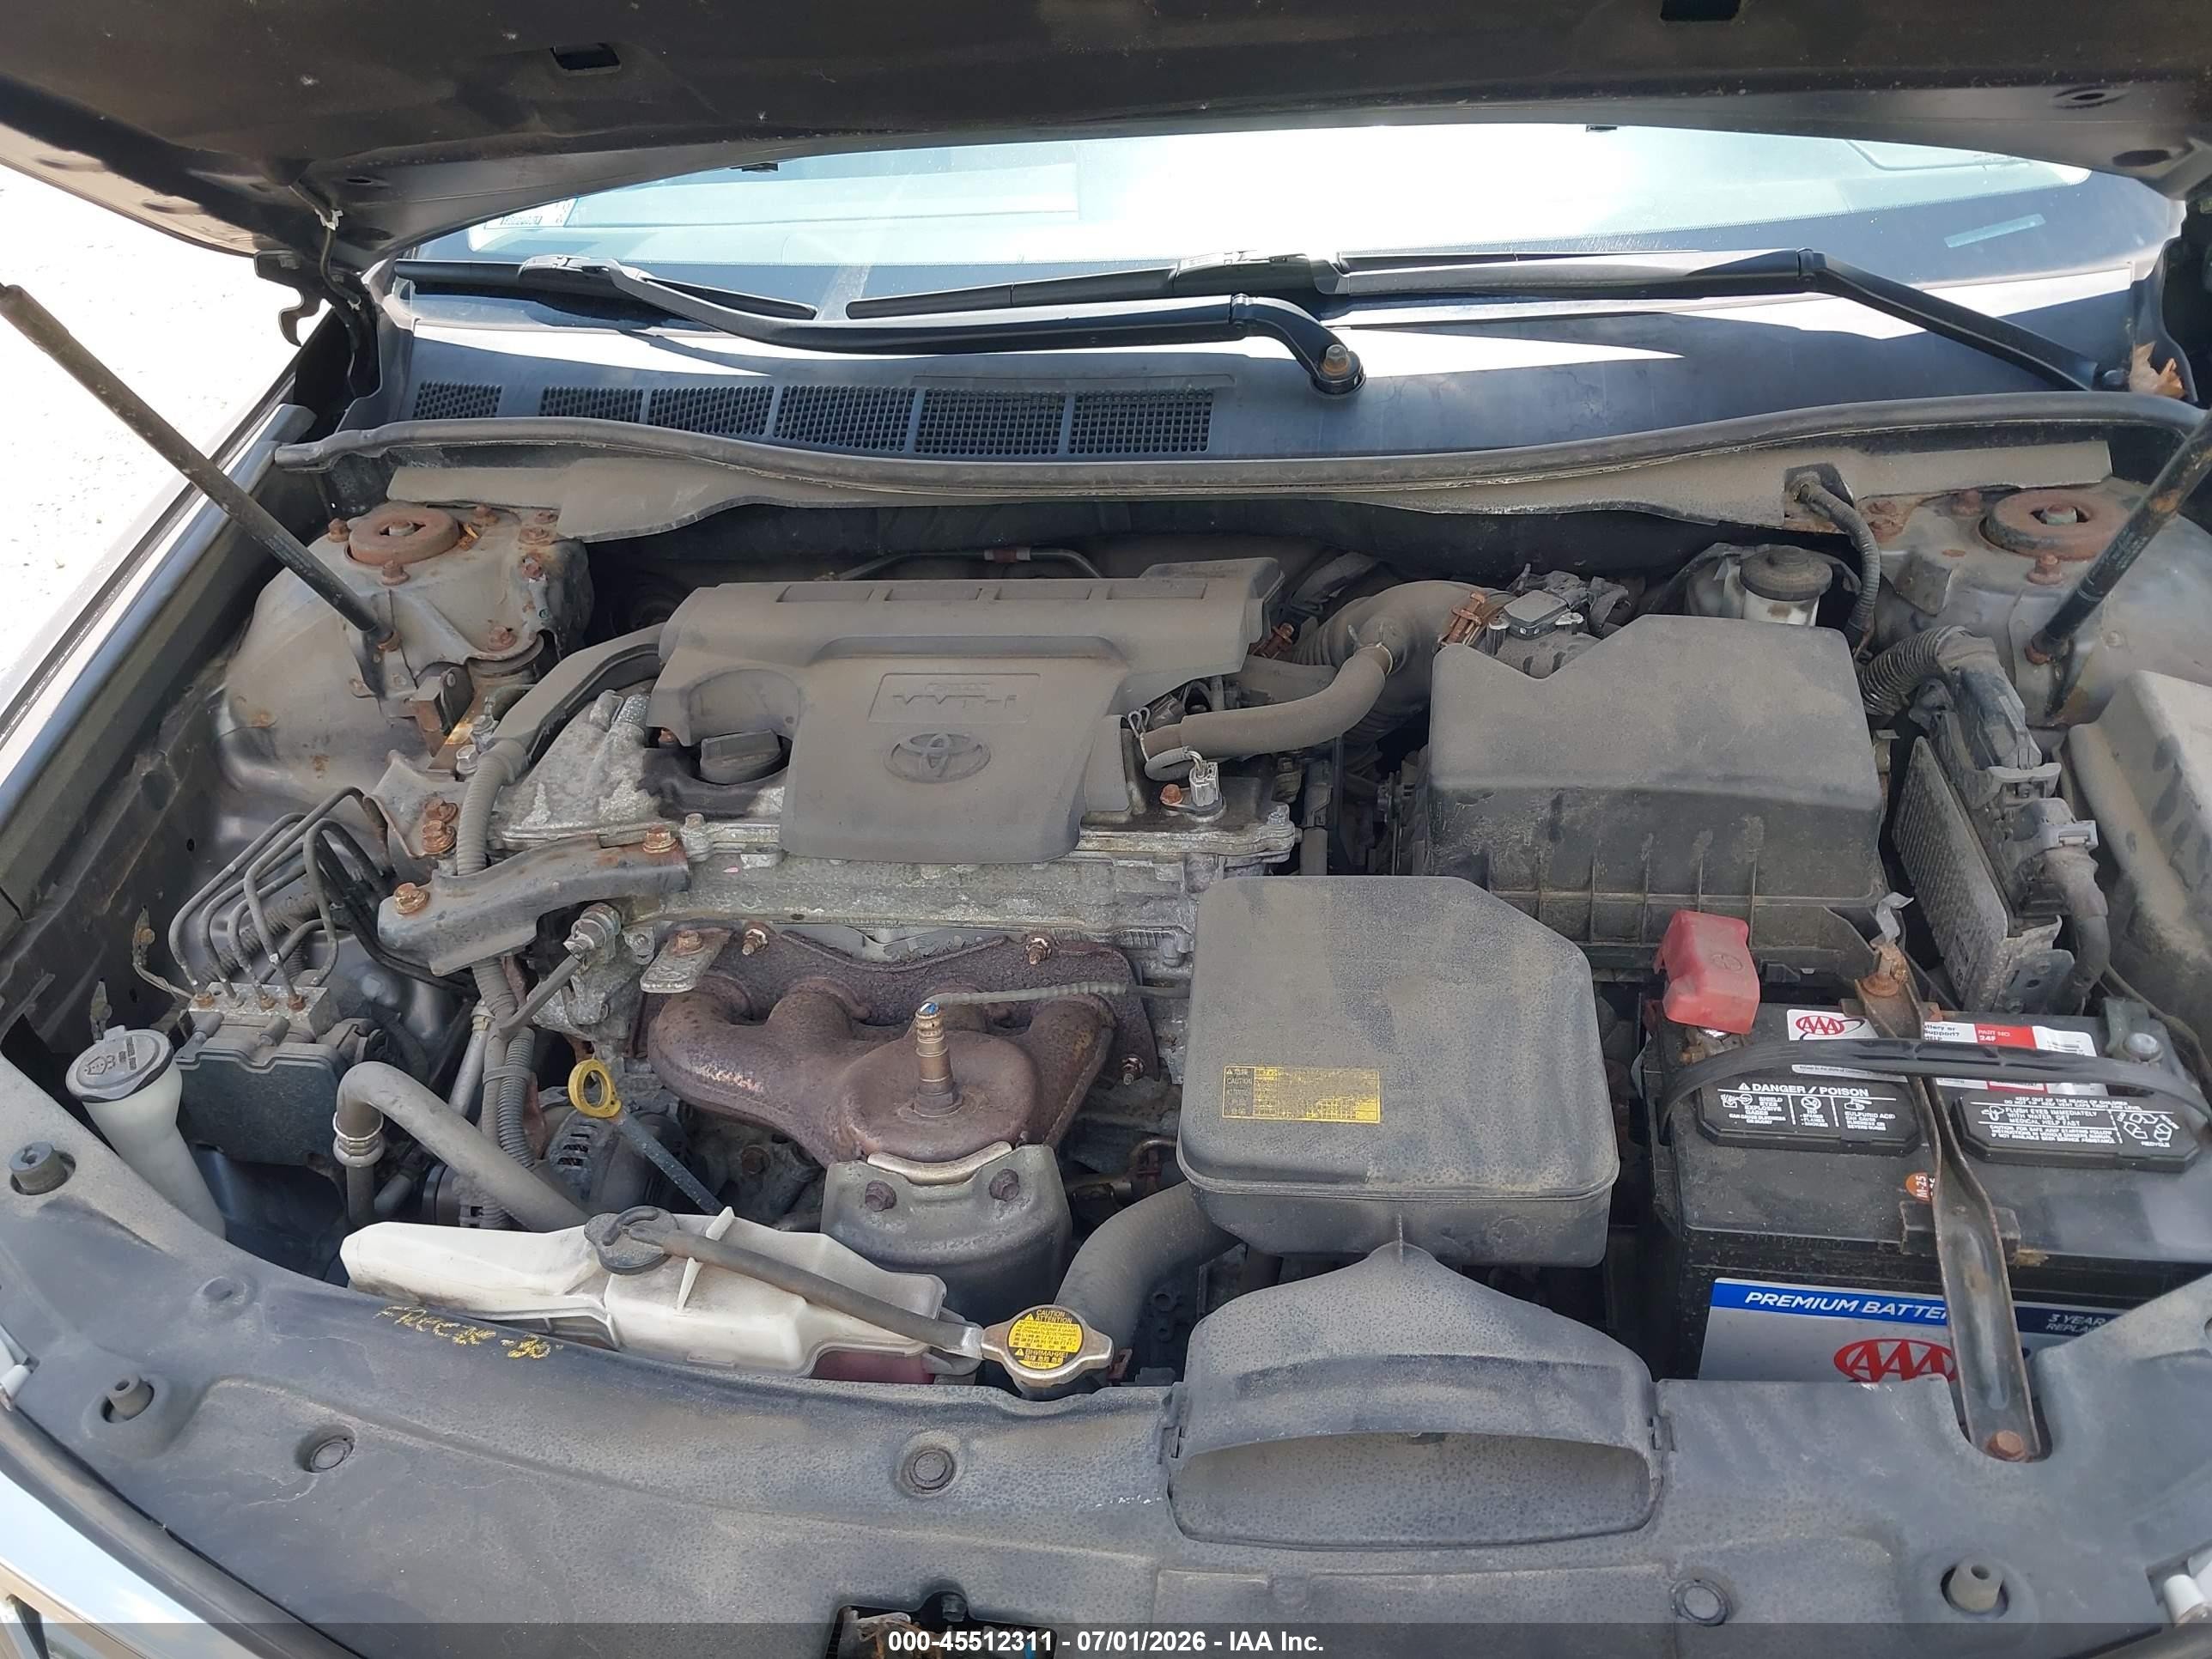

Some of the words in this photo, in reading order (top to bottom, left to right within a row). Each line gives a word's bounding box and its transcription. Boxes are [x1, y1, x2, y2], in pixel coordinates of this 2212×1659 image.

[1796, 1015, 1844, 1036] AAA
[1752, 1083, 1806, 1094] DANGER
[1819, 1086, 1869, 1097] POISON
[1744, 1291, 1856, 1312] PREMIUM
[1035, 1316, 1073, 1325] ATTENTION
[1036, 1309, 1066, 1318] CAUTION
[1836, 1338, 1957, 1382] AAA
